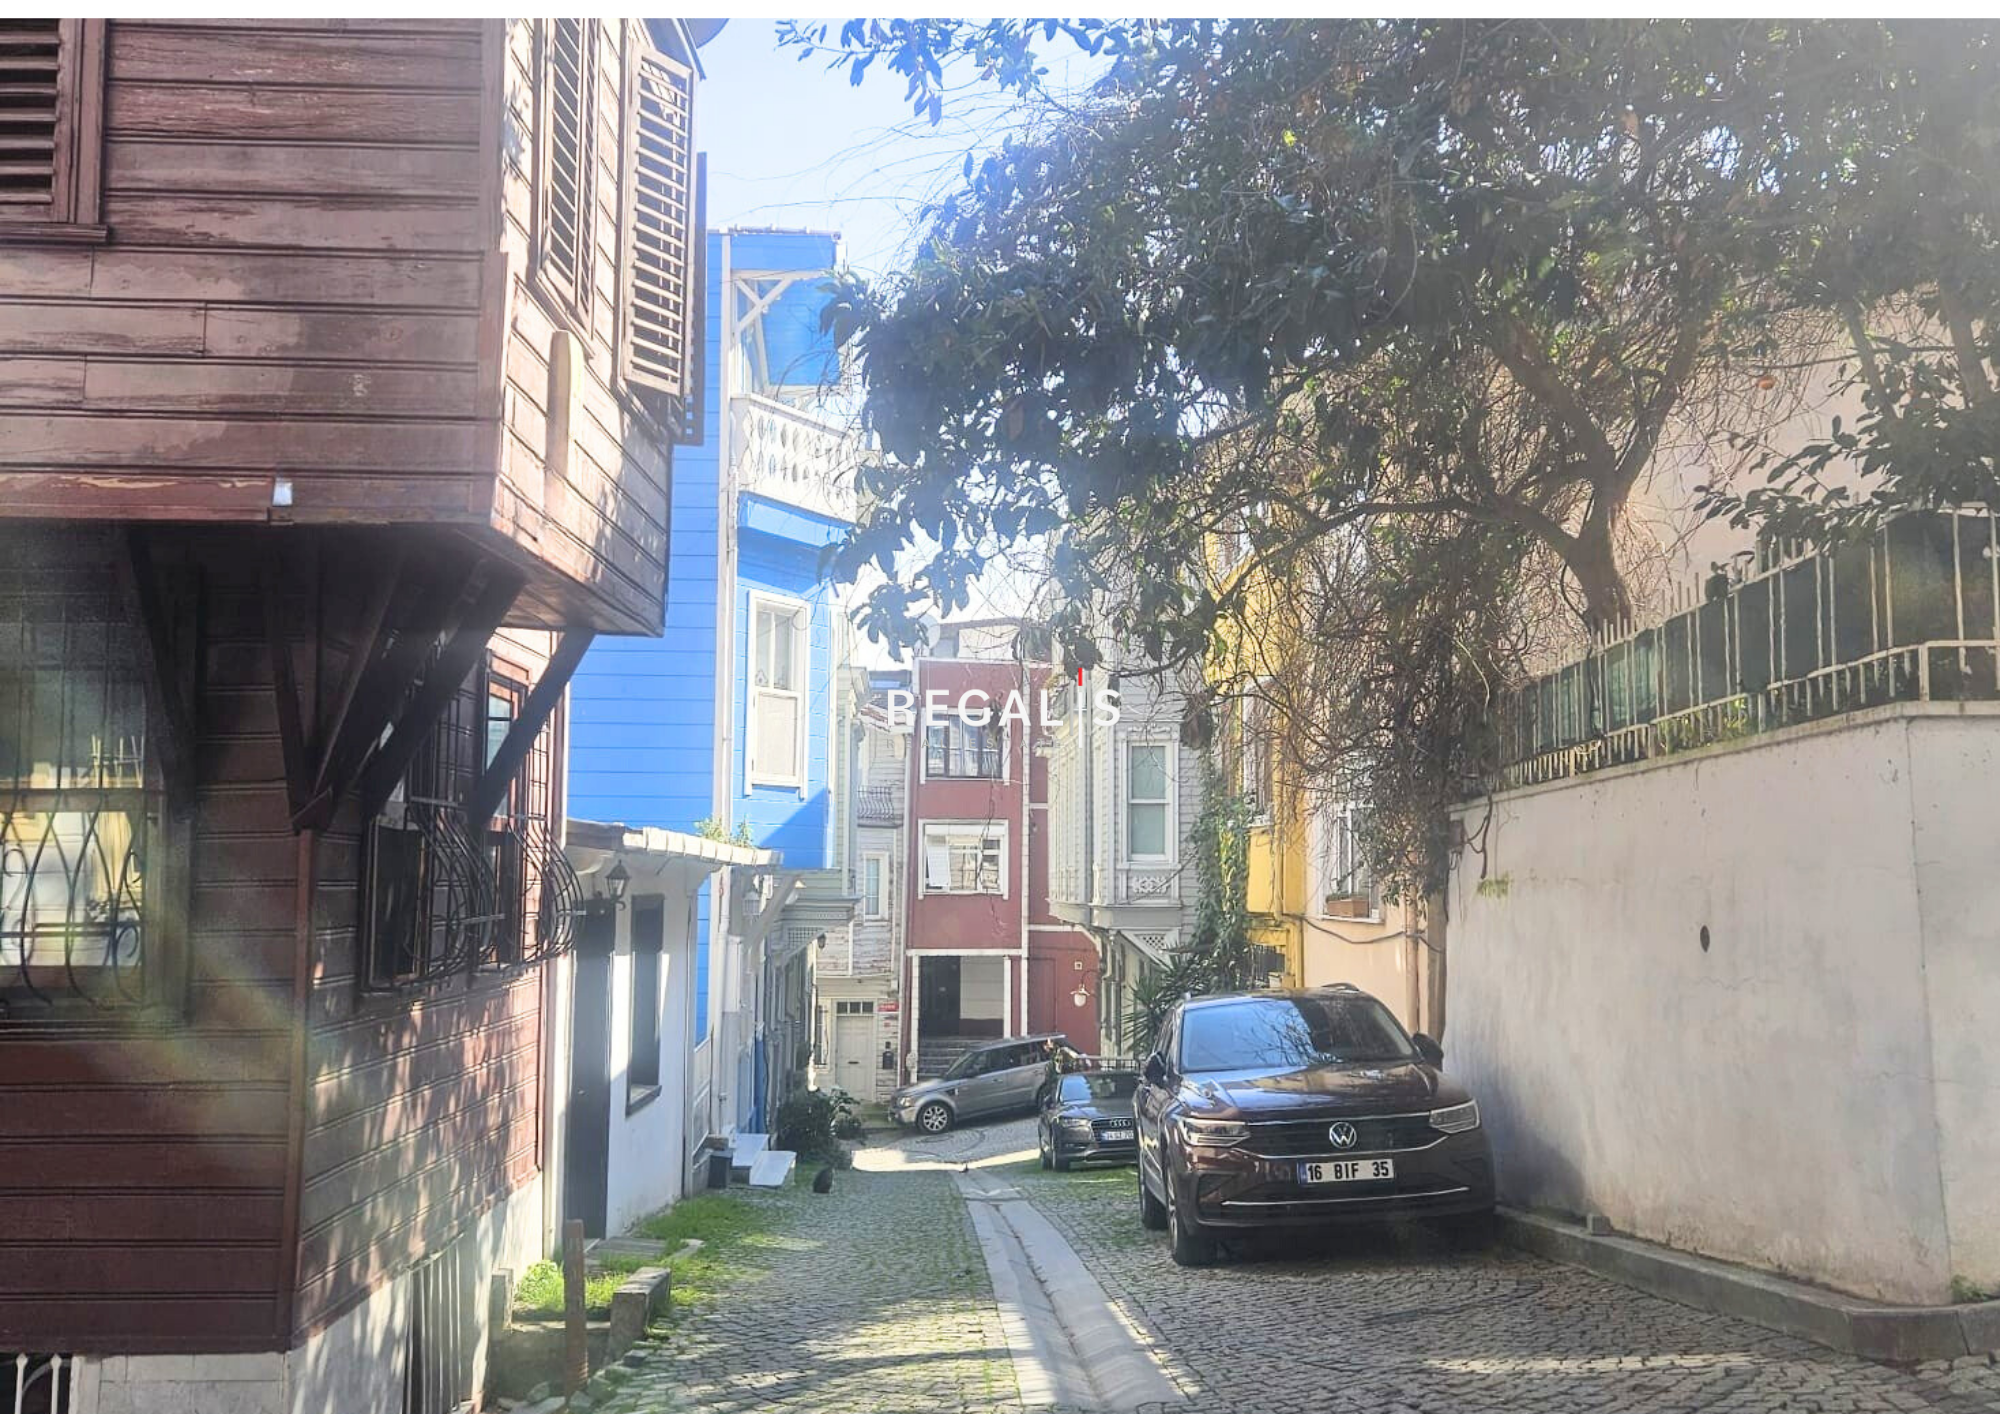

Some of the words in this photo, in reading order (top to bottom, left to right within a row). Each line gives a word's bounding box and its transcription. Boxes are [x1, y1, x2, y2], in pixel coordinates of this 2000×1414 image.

[1307, 1165, 1322, 1181] 16
[1334, 1163, 1359, 1179] BIF
[1371, 1161, 1389, 1177] 35
